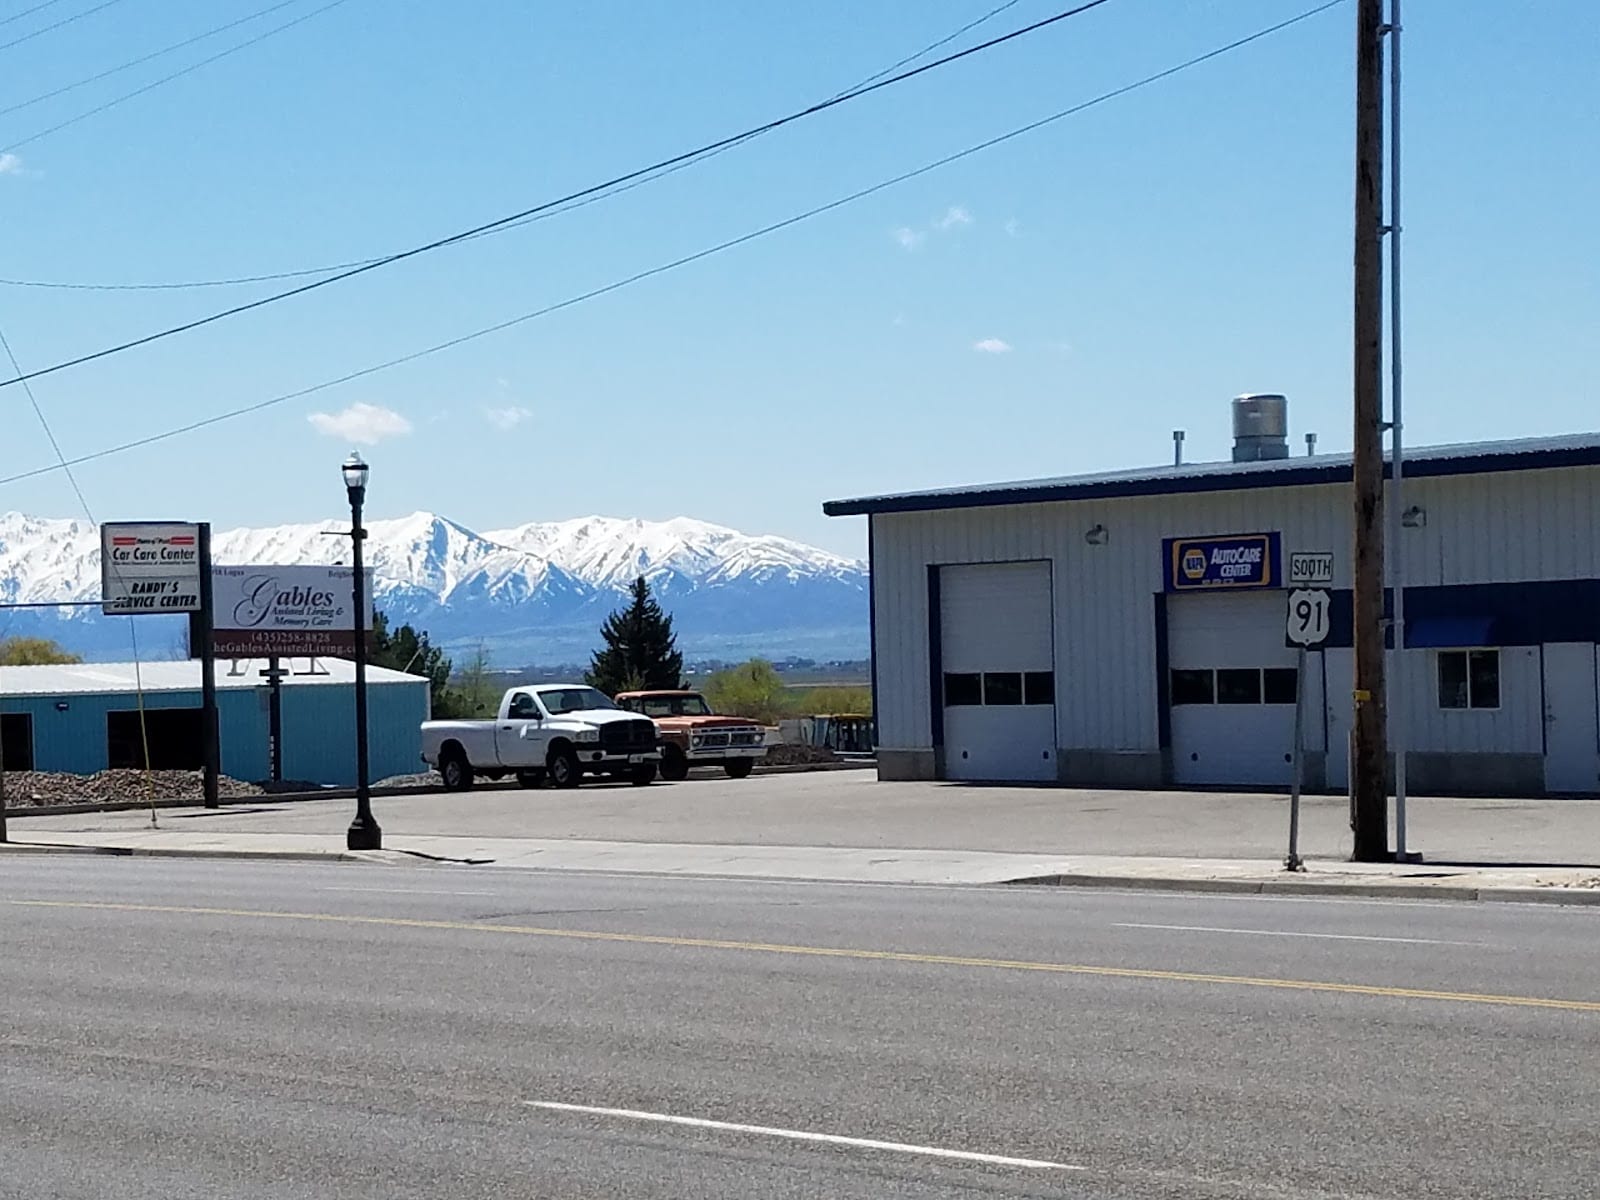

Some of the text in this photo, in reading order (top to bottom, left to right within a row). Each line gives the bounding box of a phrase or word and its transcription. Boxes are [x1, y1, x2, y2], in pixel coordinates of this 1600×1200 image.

[113, 547, 194, 560] Car Care Center
[1220, 564, 1251, 577] CENTER
[1293, 559, 1331, 576] SOUTH
[131, 581, 179, 594] RANDY'S
[113, 595, 197, 608] SERVICE CENTER
[234, 574, 334, 627] Gables
[306, 606, 334, 618] Living
[336, 607, 344, 616] &
[1296, 600, 1322, 632] 91
[312, 617, 332, 626] Care
